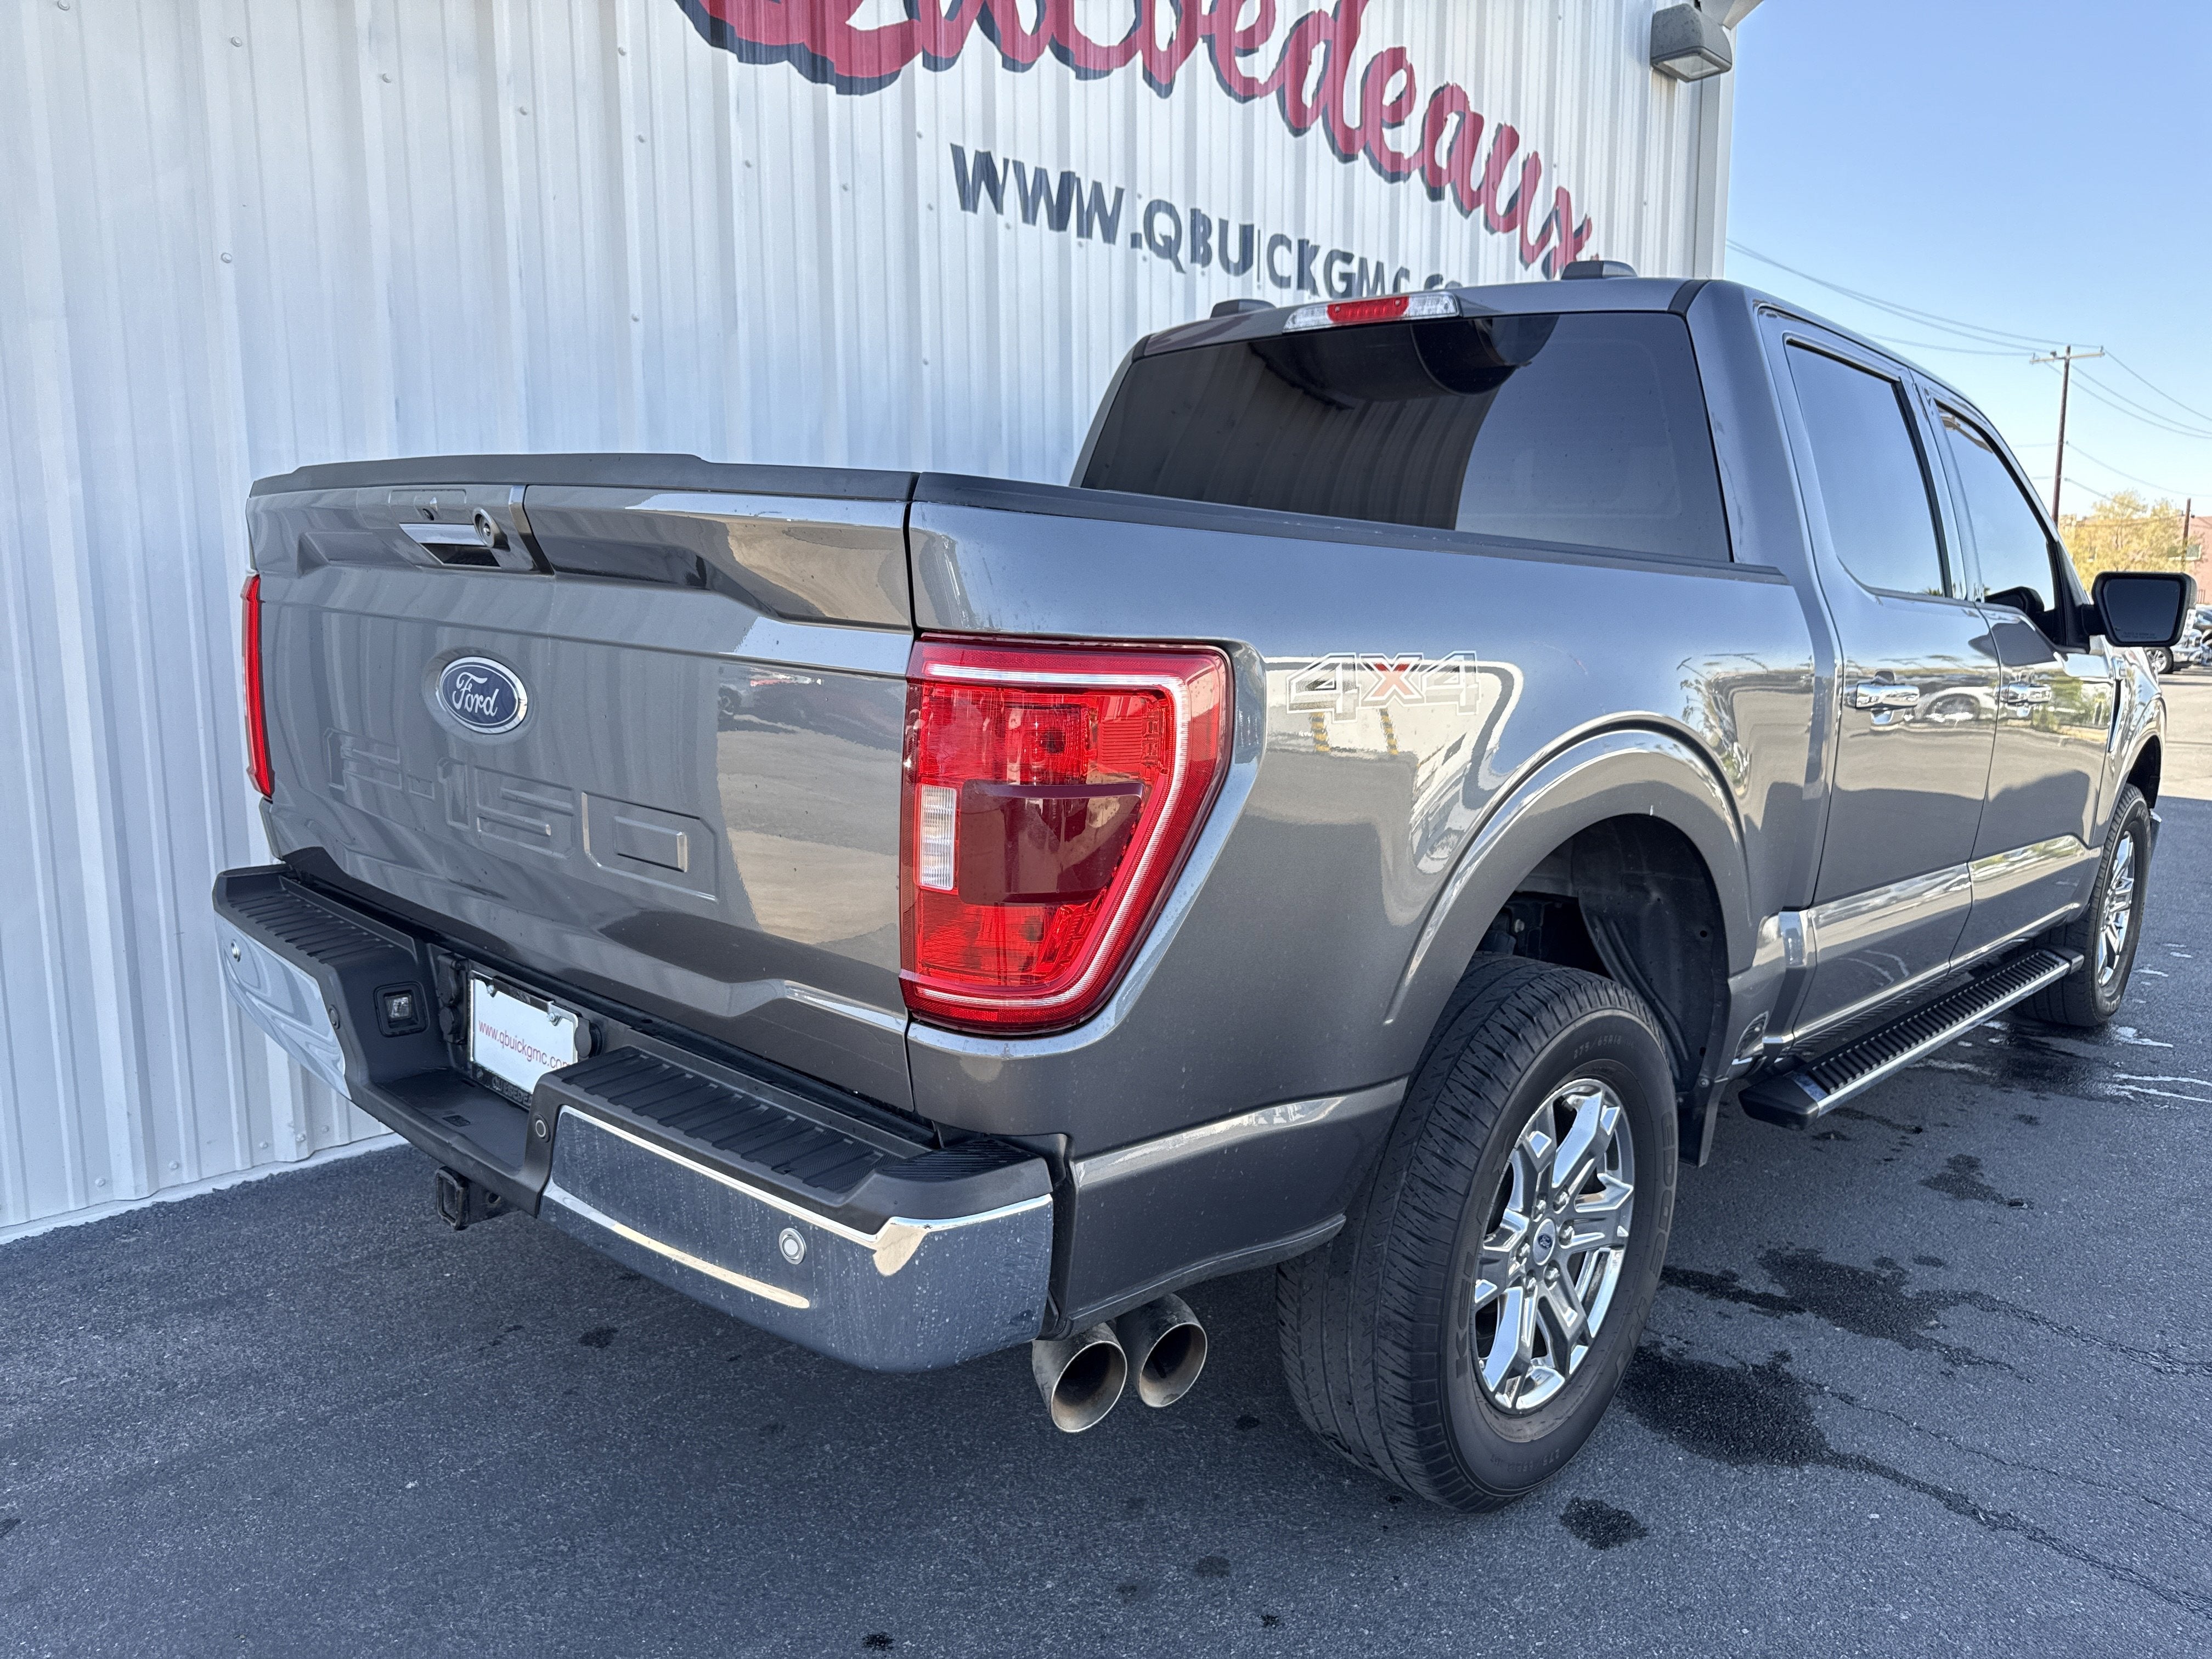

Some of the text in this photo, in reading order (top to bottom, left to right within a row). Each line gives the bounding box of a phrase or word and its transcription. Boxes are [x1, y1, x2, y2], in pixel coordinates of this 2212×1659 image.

[675, 0, 1599, 280] edeaux
[951, 144, 1463, 299] WWW.QBUICKGMC
[453, 671, 499, 716] Ford
[324, 727, 719, 902] F-150
[1650, 1111, 1674, 1278] EDGE
